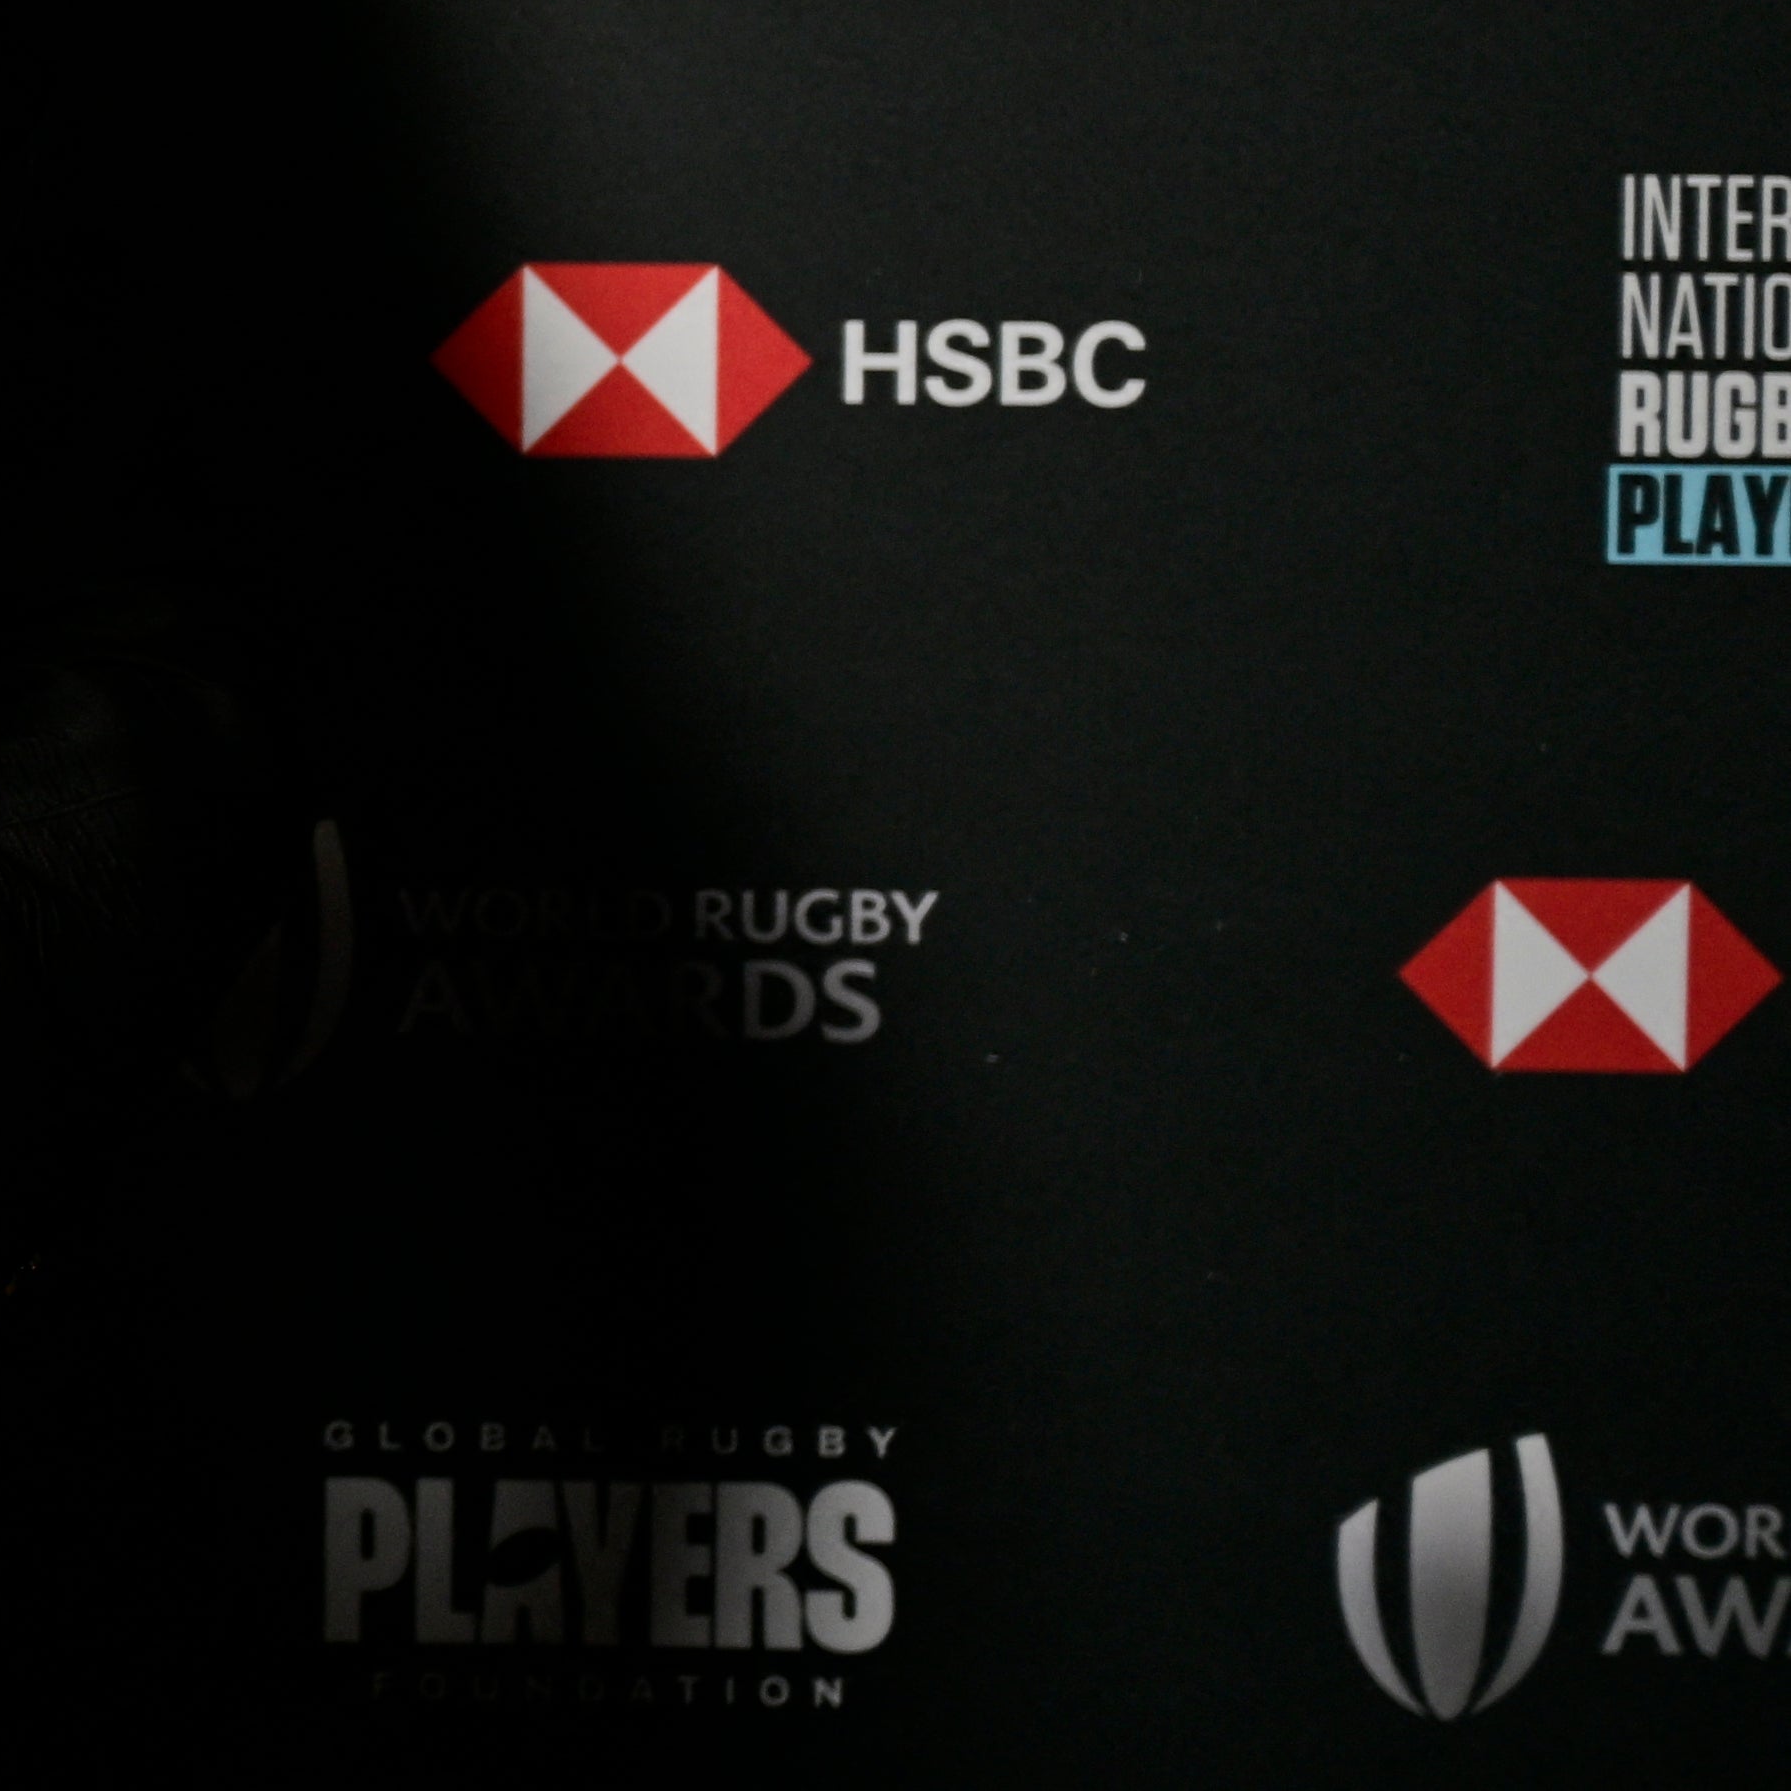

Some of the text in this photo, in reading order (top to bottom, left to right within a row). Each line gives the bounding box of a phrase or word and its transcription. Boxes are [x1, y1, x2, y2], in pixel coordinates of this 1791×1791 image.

[1623, 174, 1791, 261] INTER
[843, 319, 1145, 407] HSBC
[695, 887, 940, 946] RUGBY
[322, 1419, 899, 1460] GLOBAL RUGBY
[325, 1477, 898, 1655] PLAYERS
[1604, 1503, 1782, 1557] WOR
